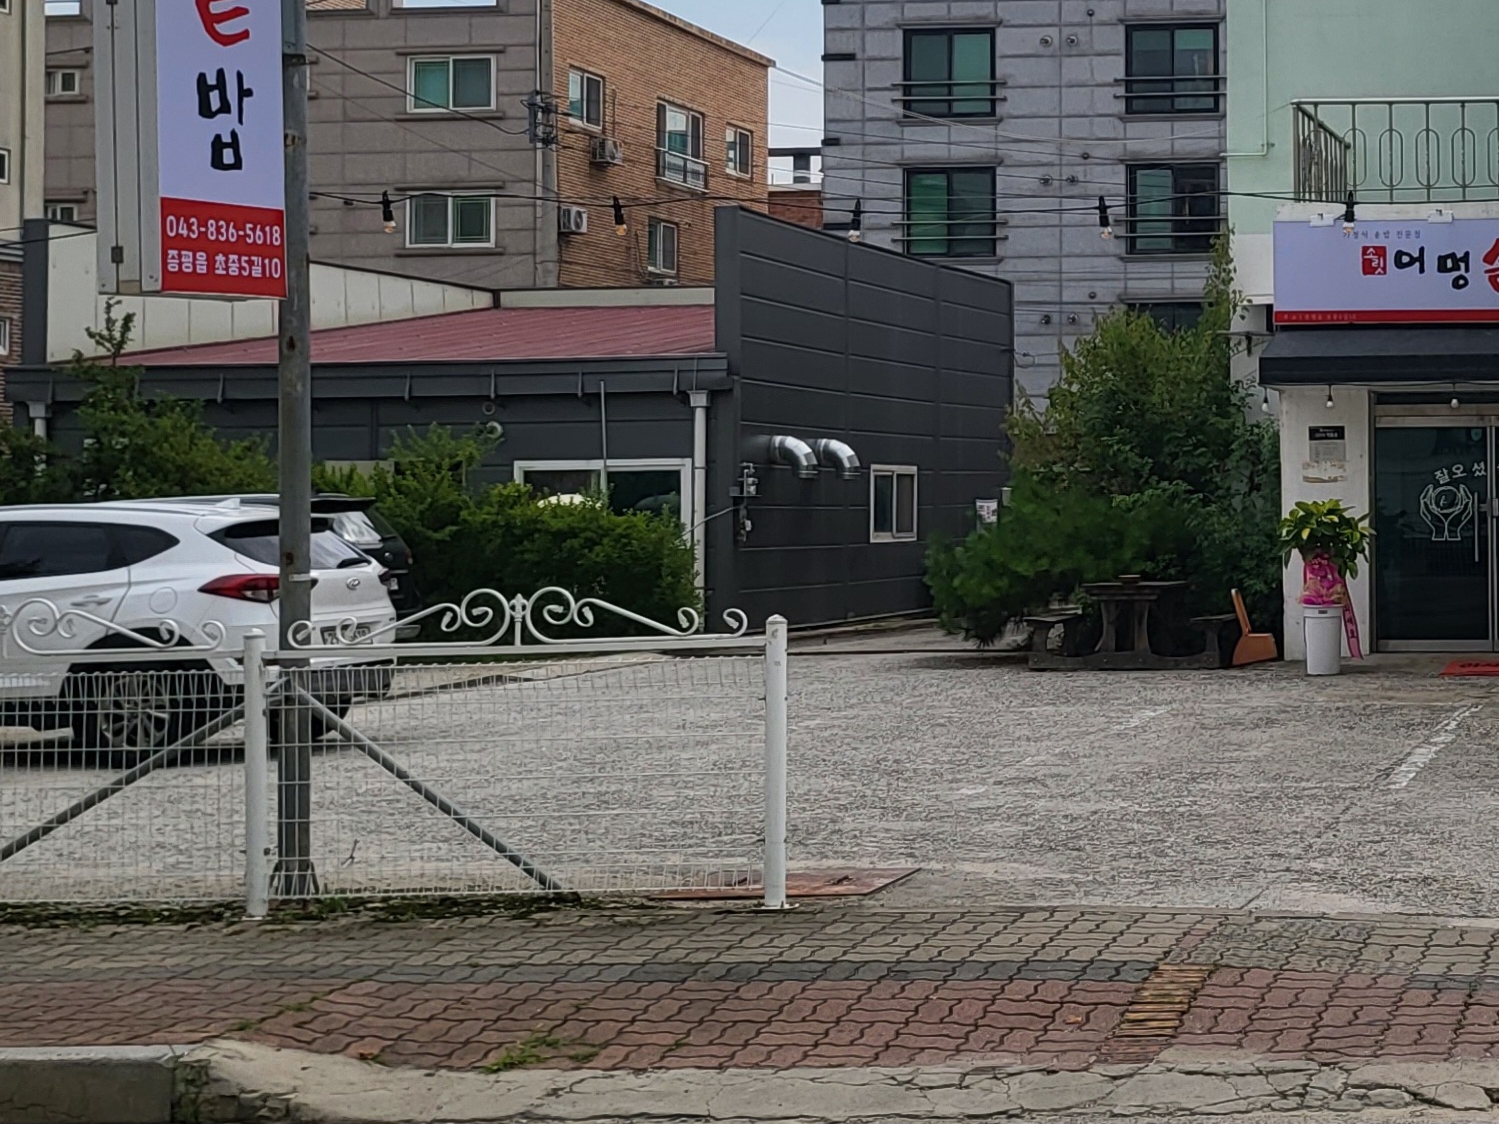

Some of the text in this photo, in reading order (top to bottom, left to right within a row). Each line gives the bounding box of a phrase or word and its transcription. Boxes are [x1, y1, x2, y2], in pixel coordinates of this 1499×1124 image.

[165, 215, 281, 246] 043-836-5618
[167, 249, 281, 279] 증평읍 초중5길10
